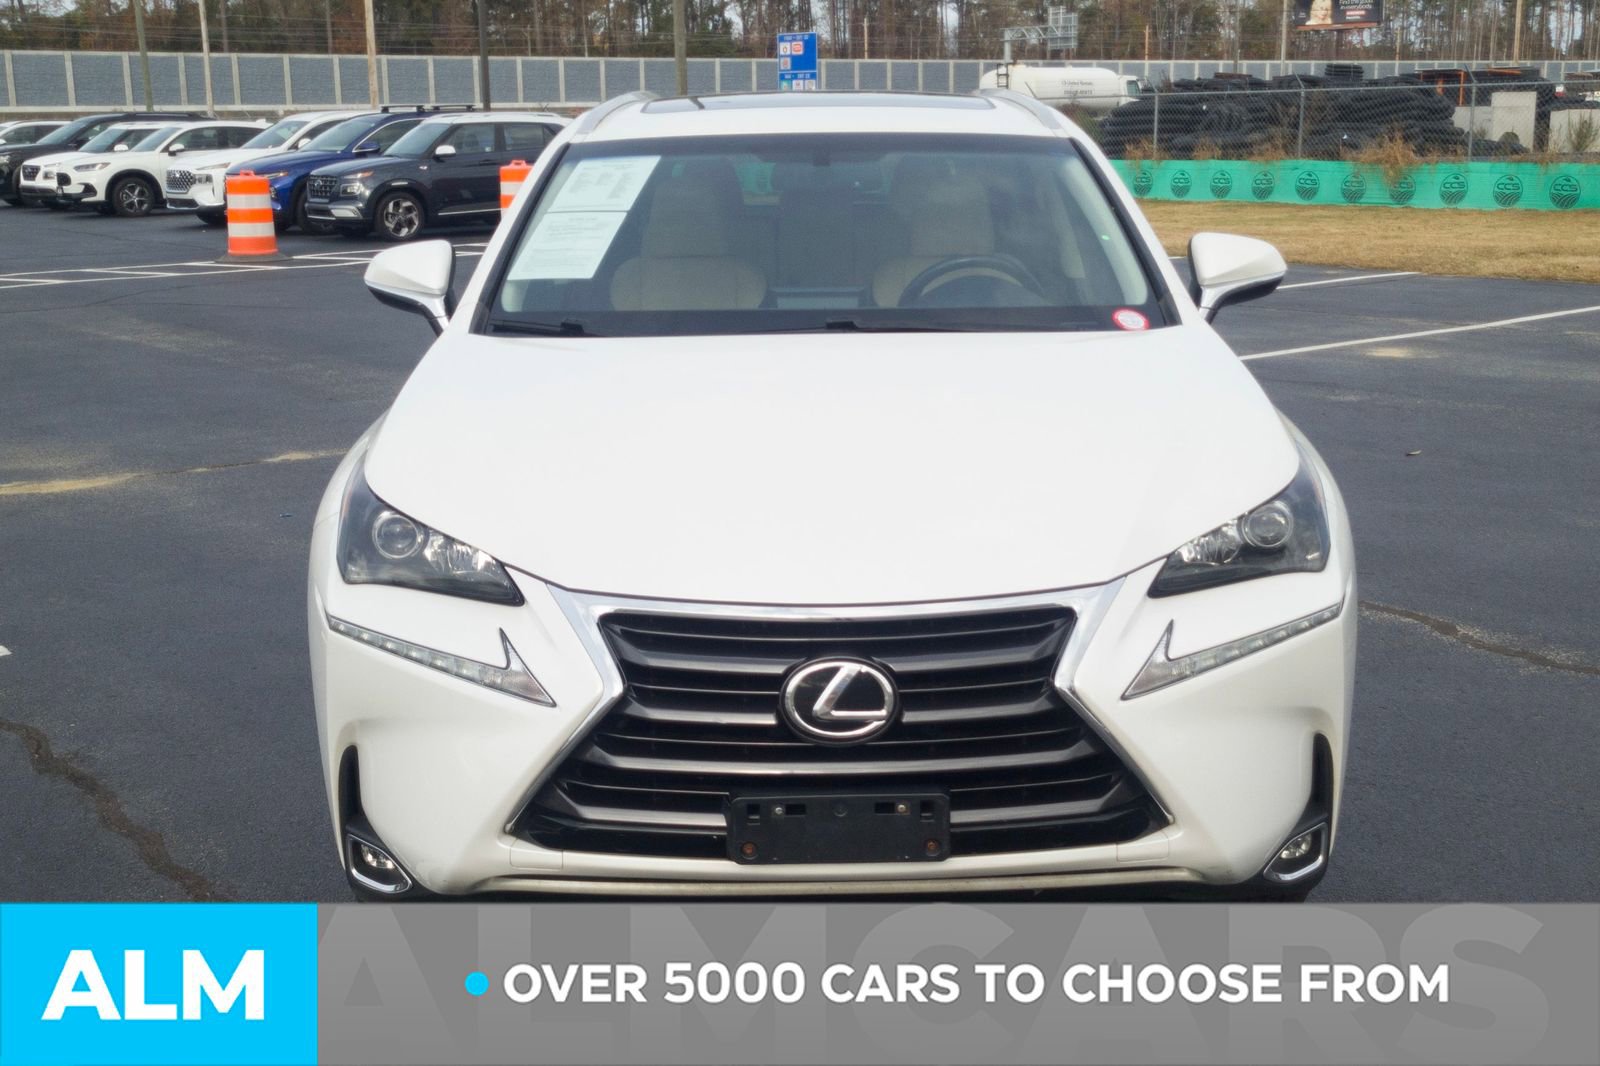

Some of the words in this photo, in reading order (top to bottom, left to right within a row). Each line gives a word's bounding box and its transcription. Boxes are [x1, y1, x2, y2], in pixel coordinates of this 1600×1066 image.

[1254, 178, 1273, 186] CCS
[1298, 178, 1317, 186] CCS
[1442, 181, 1465, 190] CCS
[1496, 182, 1521, 191] CCS
[1553, 183, 1578, 193] CCS
